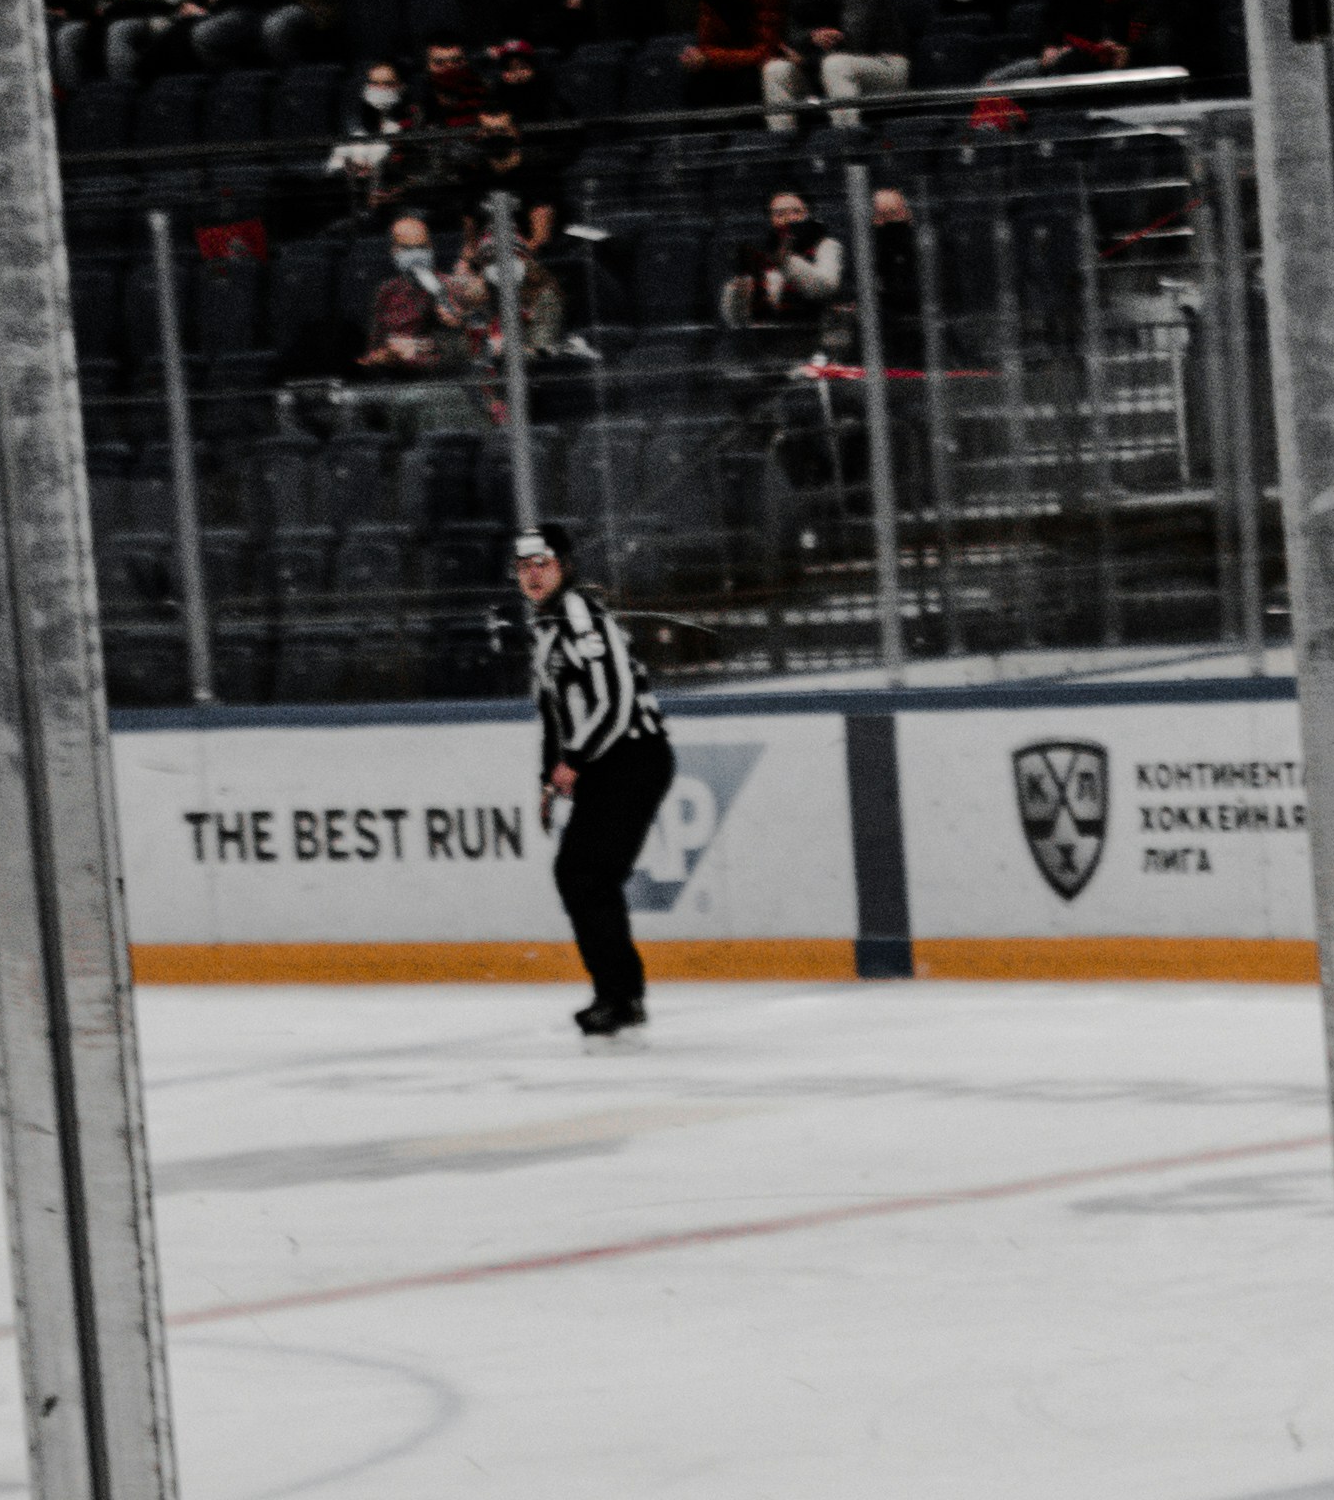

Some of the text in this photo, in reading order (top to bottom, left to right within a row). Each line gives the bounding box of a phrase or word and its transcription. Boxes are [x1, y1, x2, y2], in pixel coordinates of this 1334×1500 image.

[1134, 761, 1305, 791] КОНТИНЕНТ
[183, 805, 525, 862] THE BEST RUN
